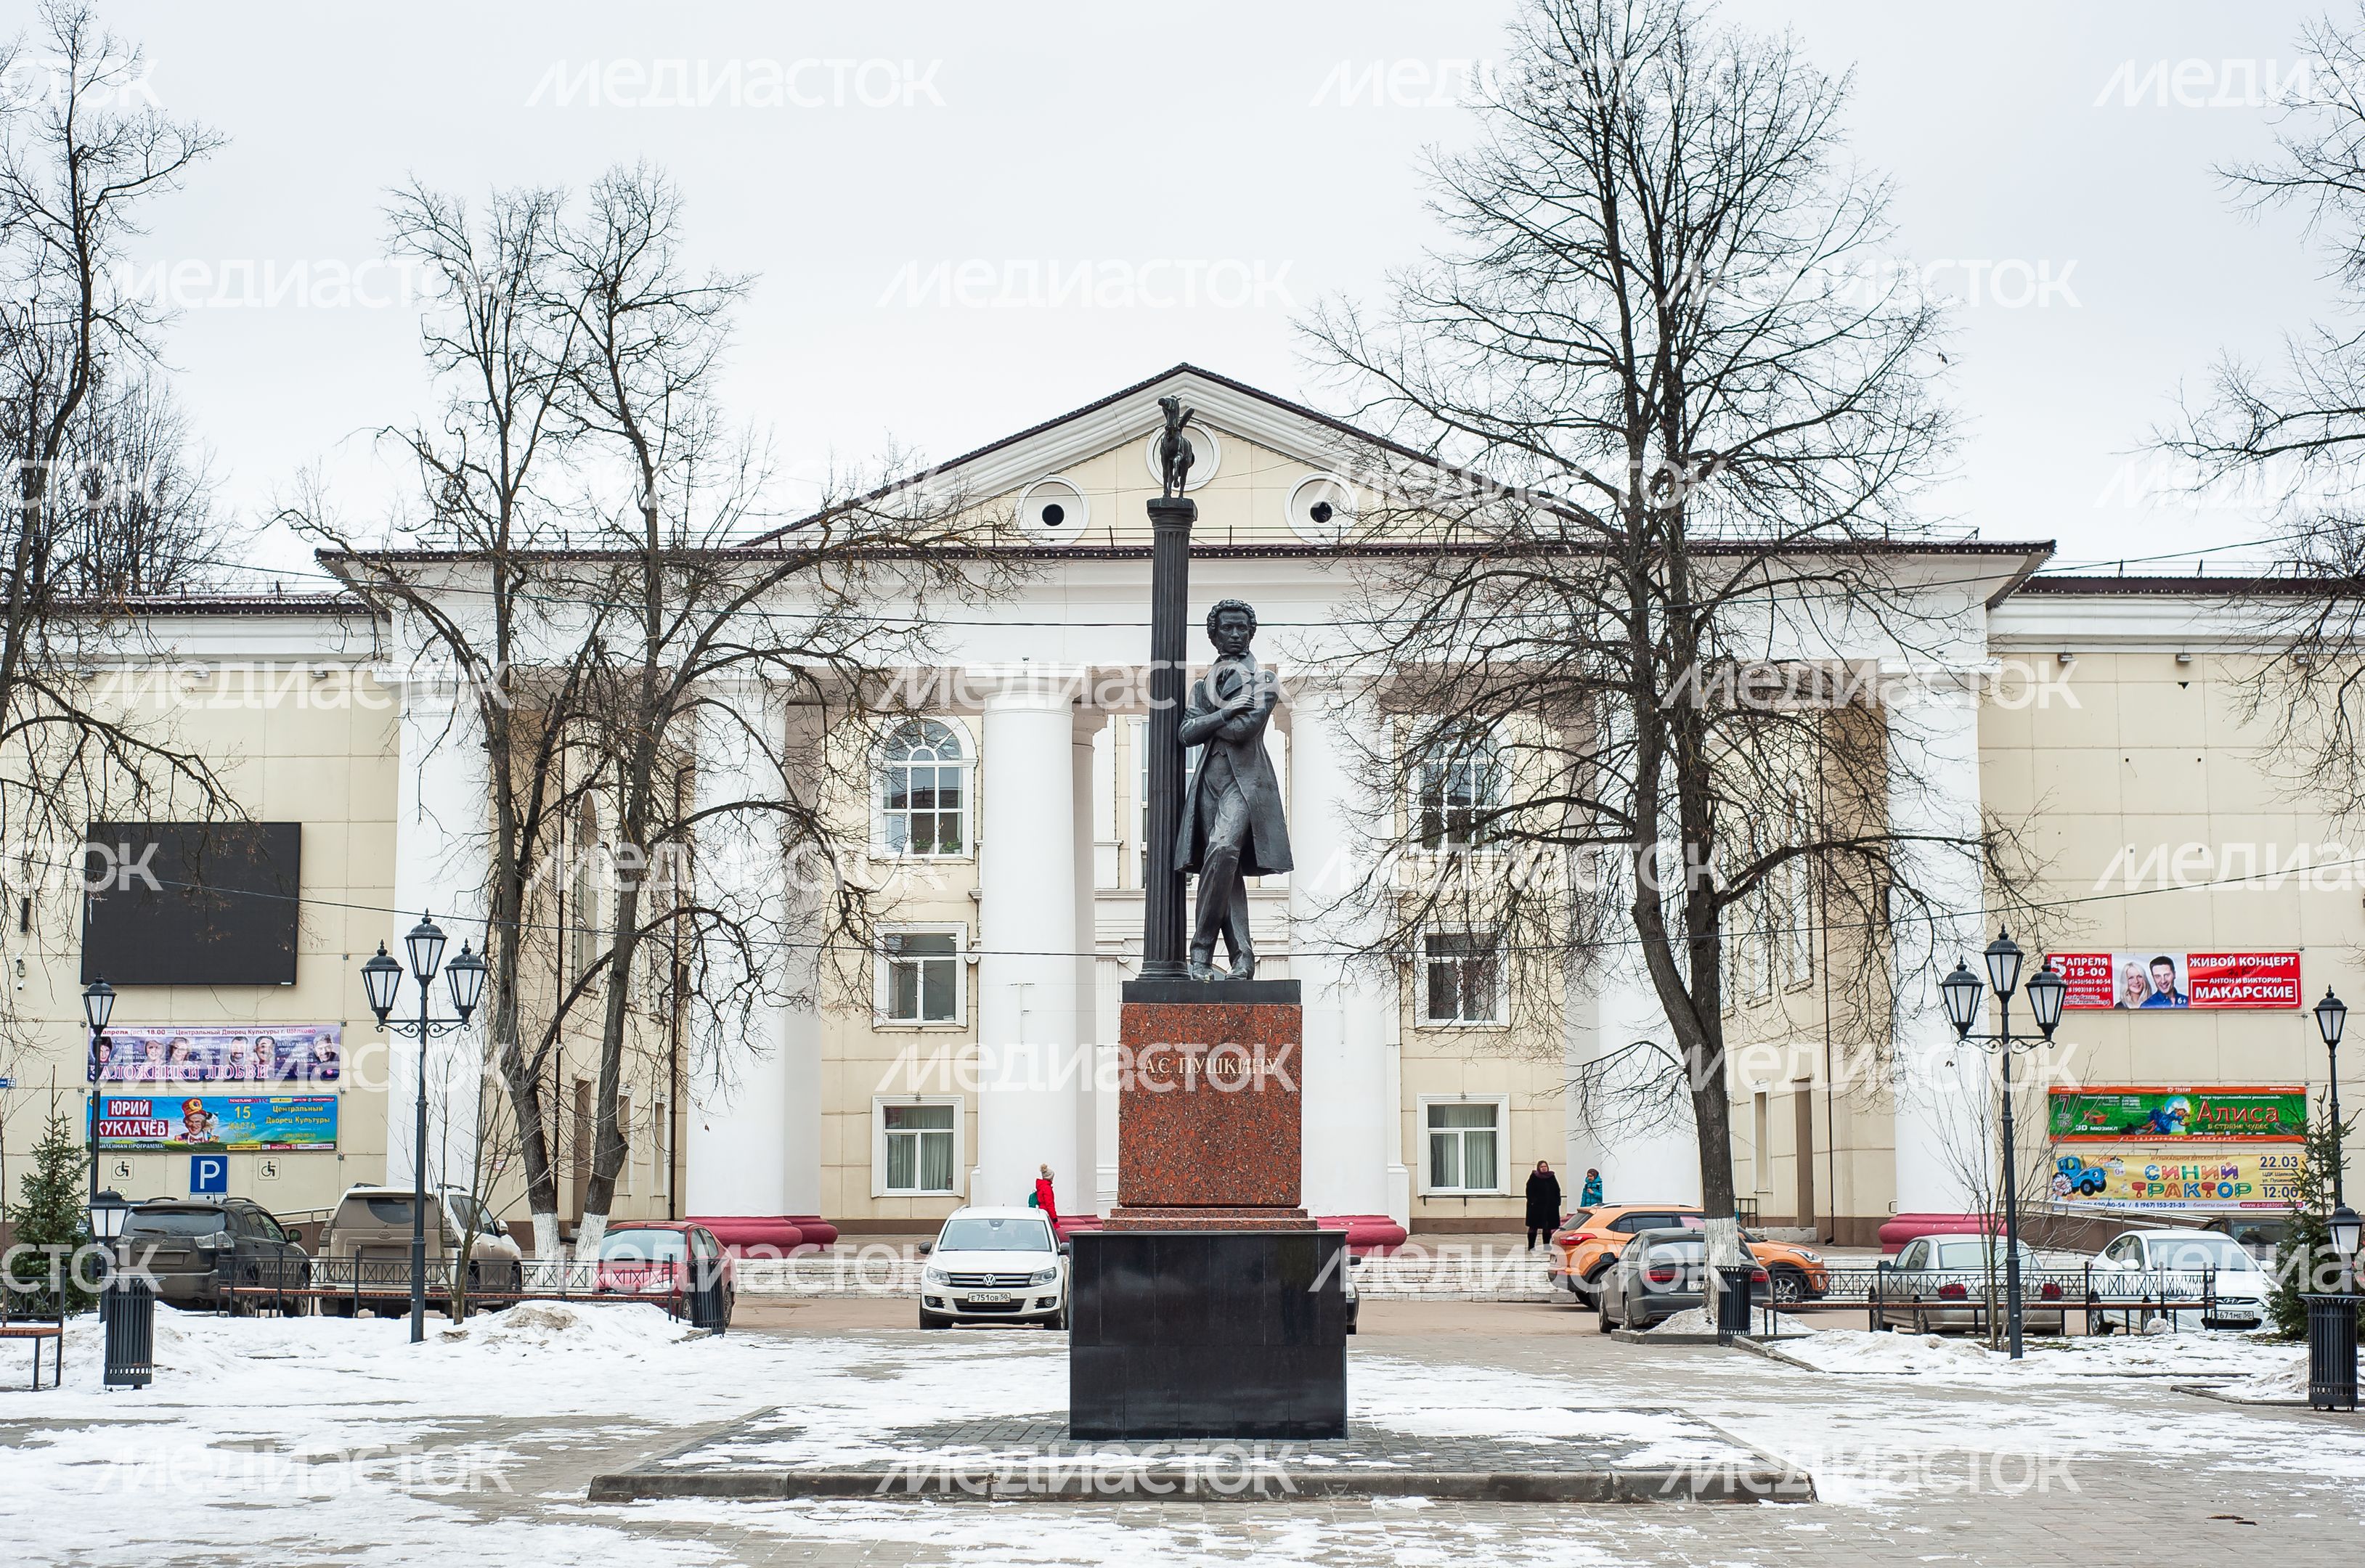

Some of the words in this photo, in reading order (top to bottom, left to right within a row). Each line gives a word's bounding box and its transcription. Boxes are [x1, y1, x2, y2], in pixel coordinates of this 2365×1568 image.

[2051, 957, 2067, 977] 5
[2067, 957, 2108, 966] АПРЕЛЯ
[2190, 956, 2236, 967] ЖИВОЙ
[2239, 957, 2295, 968] КОНЦЕРТ
[2069, 968, 2106, 976] 18-00
[2195, 986, 2294, 998] МАКАРСКИЕ
[205, 1064, 269, 1079] ЛЮБВИ
[1178, 1057, 1279, 1074] ПУШКИНУ
[110, 1099, 150, 1115] ЮРИЙ
[235, 1106, 251, 1119] 15
[272, 1105, 324, 1114] Центральный
[2197, 1100, 2279, 1123] Алиса
[295, 1116, 331, 1124] Культуры
[2260, 1156, 2298, 1167] 22.03
[200, 1160, 220, 1189] P
[2145, 1162, 2239, 1180] СИНИЙ
[2132, 1182, 2252, 1199] ТРАКТОР
[2263, 1186, 2298, 1198] 12:00
